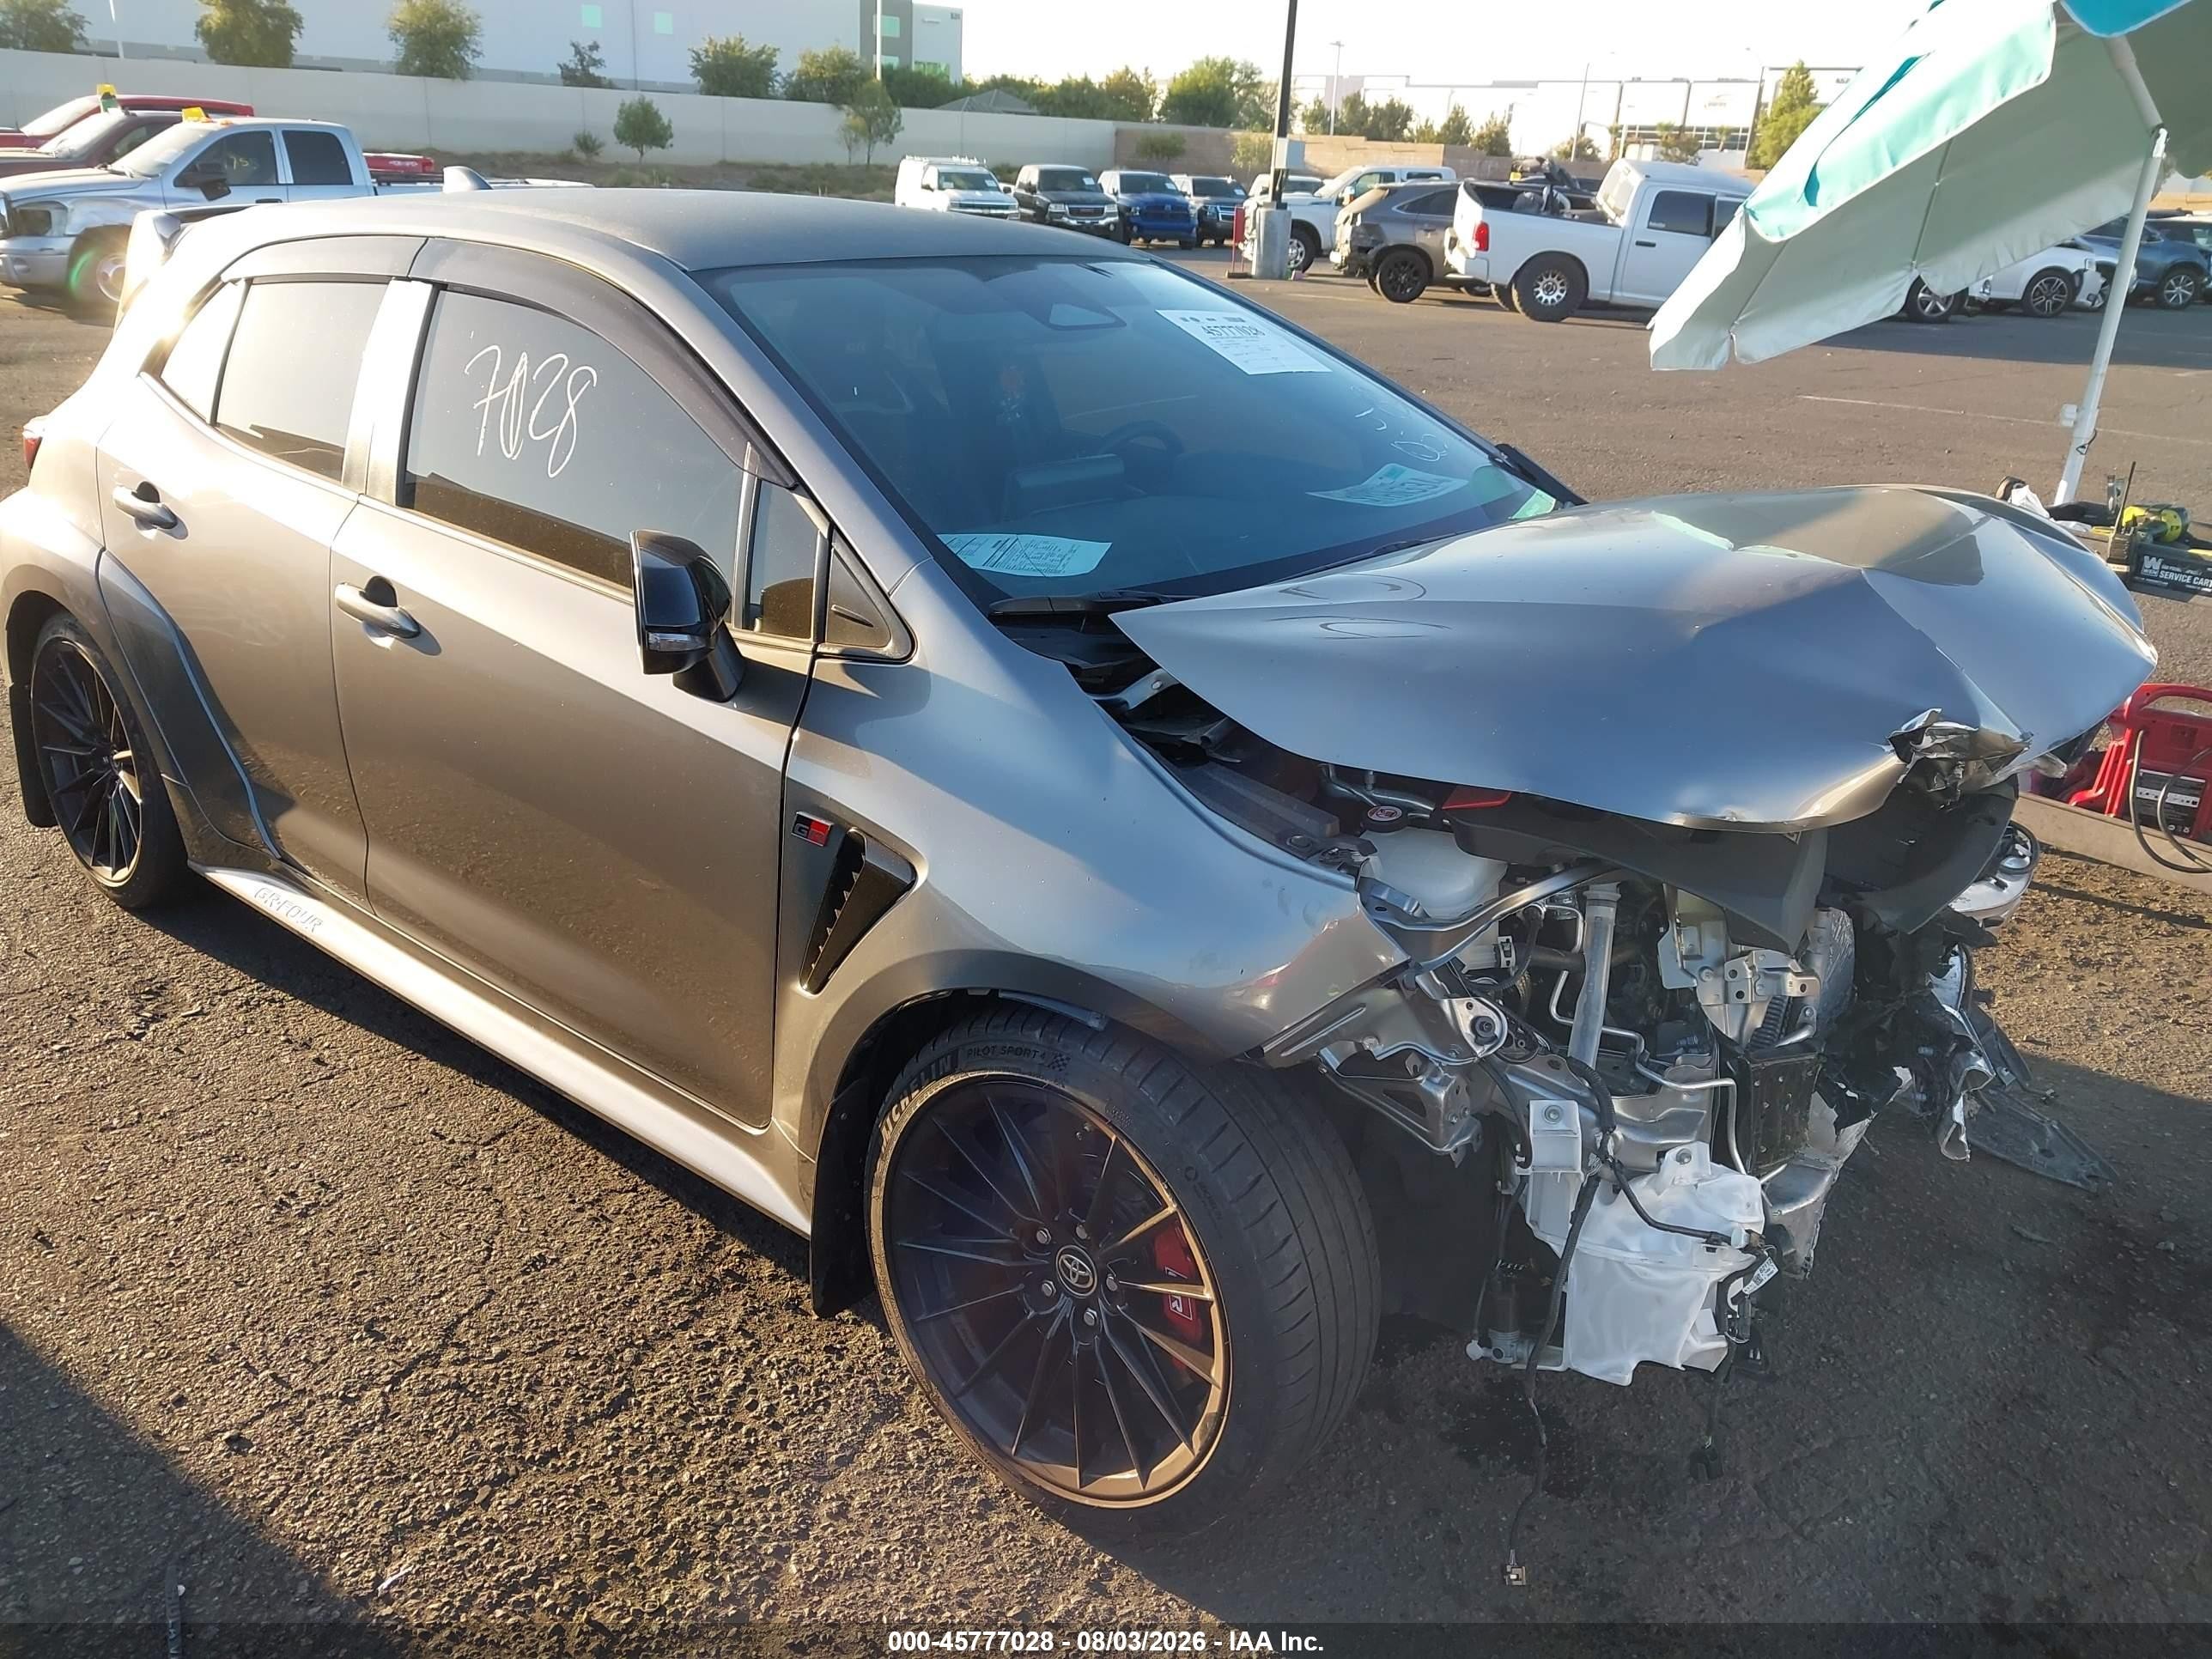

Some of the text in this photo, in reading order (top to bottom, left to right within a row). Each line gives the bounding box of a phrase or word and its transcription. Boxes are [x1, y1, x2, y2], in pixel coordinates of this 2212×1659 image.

[2159, 570, 2192, 583] SERVICE
[967, 1046, 996, 1059] PILOT
[1000, 1046, 1039, 1059] SPORT
